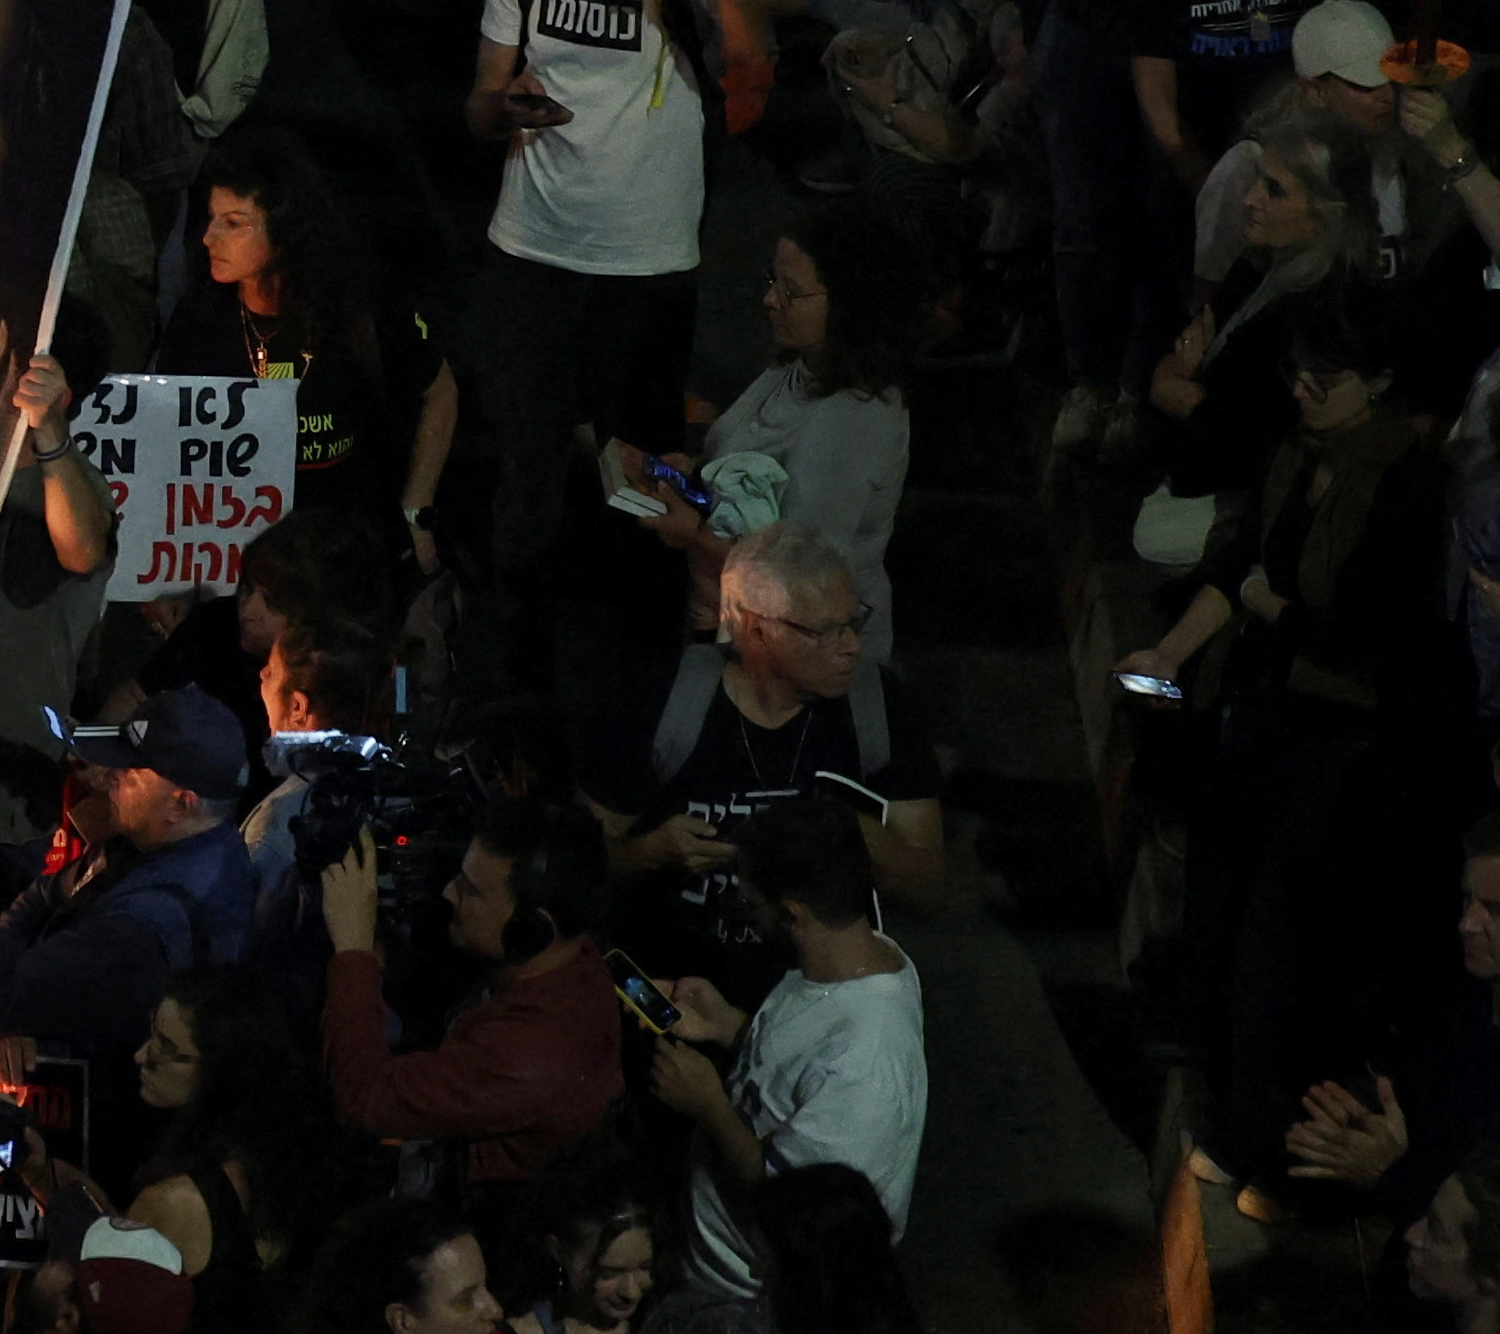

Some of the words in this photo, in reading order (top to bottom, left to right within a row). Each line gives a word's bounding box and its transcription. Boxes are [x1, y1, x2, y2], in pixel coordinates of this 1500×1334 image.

[178, 380, 260, 430] לא
[299, 413, 335, 435] אשכ
[179, 433, 260, 477] שום
[166, 483, 284, 535] בזמן
